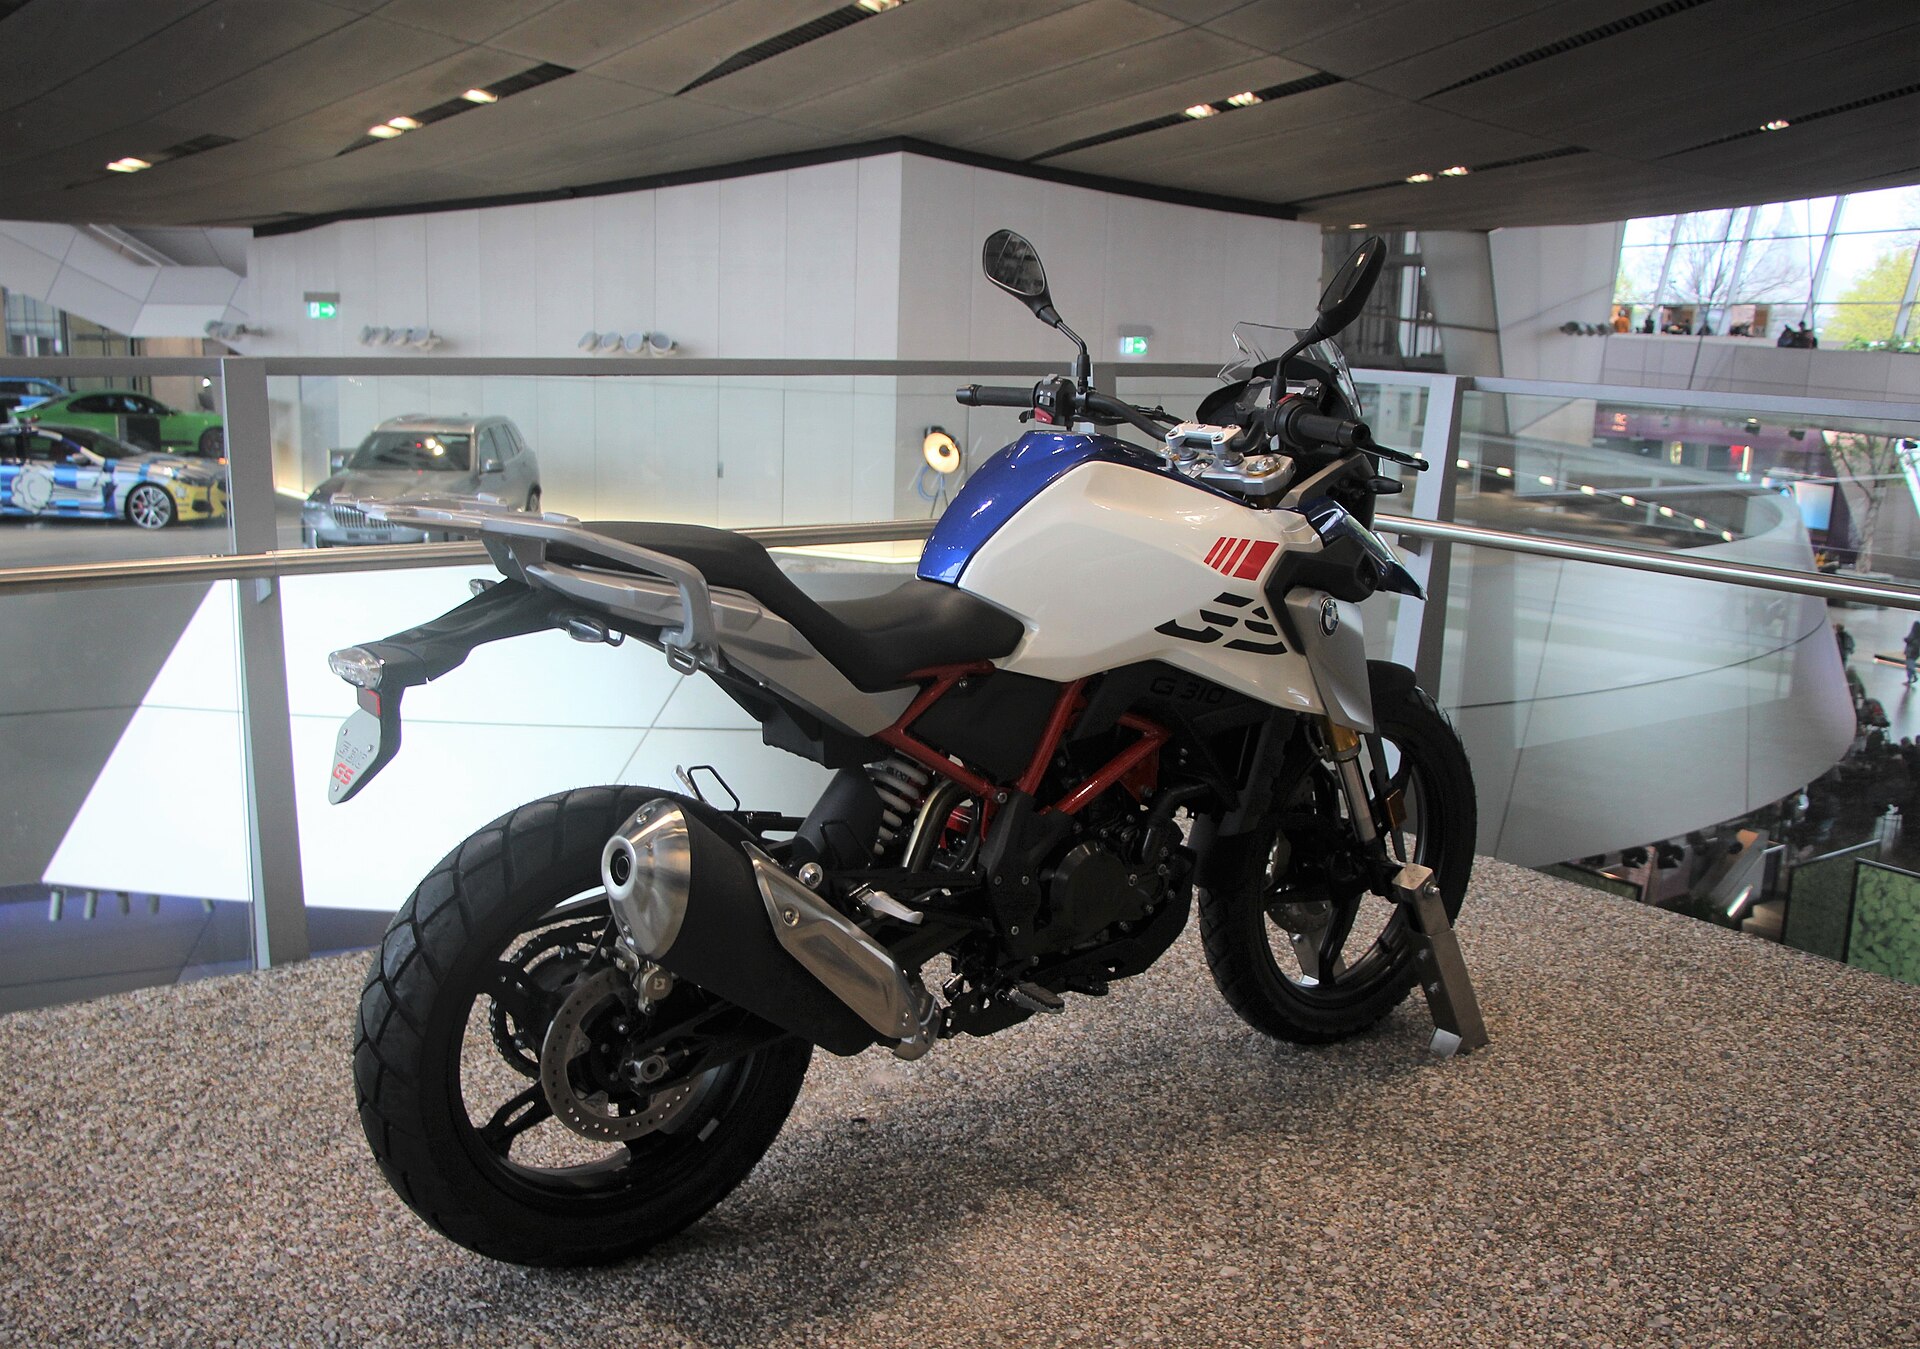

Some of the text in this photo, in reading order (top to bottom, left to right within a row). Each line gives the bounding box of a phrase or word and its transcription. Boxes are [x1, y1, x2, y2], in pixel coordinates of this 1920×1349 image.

[1154, 592, 1288, 655] GS
[1150, 677, 1227, 704] G 310
[333, 762, 355, 785] GS
